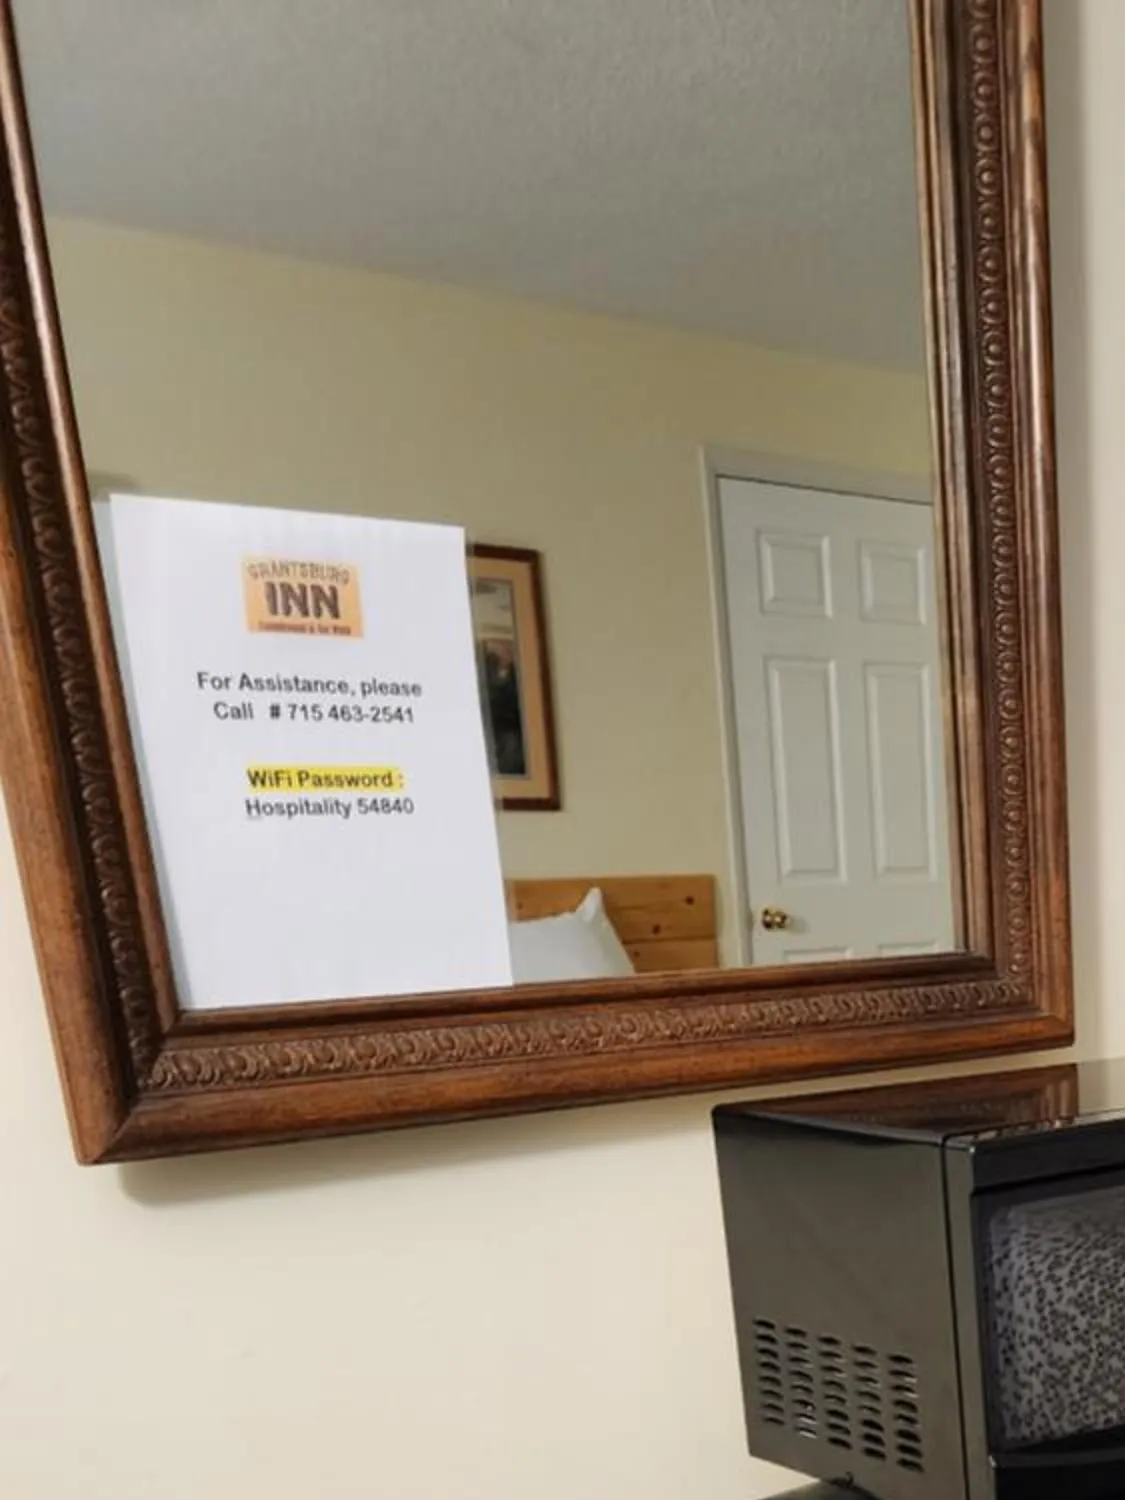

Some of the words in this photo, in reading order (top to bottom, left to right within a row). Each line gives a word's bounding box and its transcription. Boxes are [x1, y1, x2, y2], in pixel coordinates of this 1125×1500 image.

[264, 580, 341, 620] INN
[197, 671, 231, 691] For
[238, 672, 355, 697] Assistance,
[360, 678, 422, 699] please
[213, 701, 254, 720] Call
[269, 703, 281, 719] #
[288, 703, 324, 721] 715
[327, 704, 414, 723] 463-2541
[247, 769, 293, 788] WiFi
[298, 770, 394, 788] Password
[246, 798, 352, 819] Hospitality
[357, 798, 414, 815] 54840
